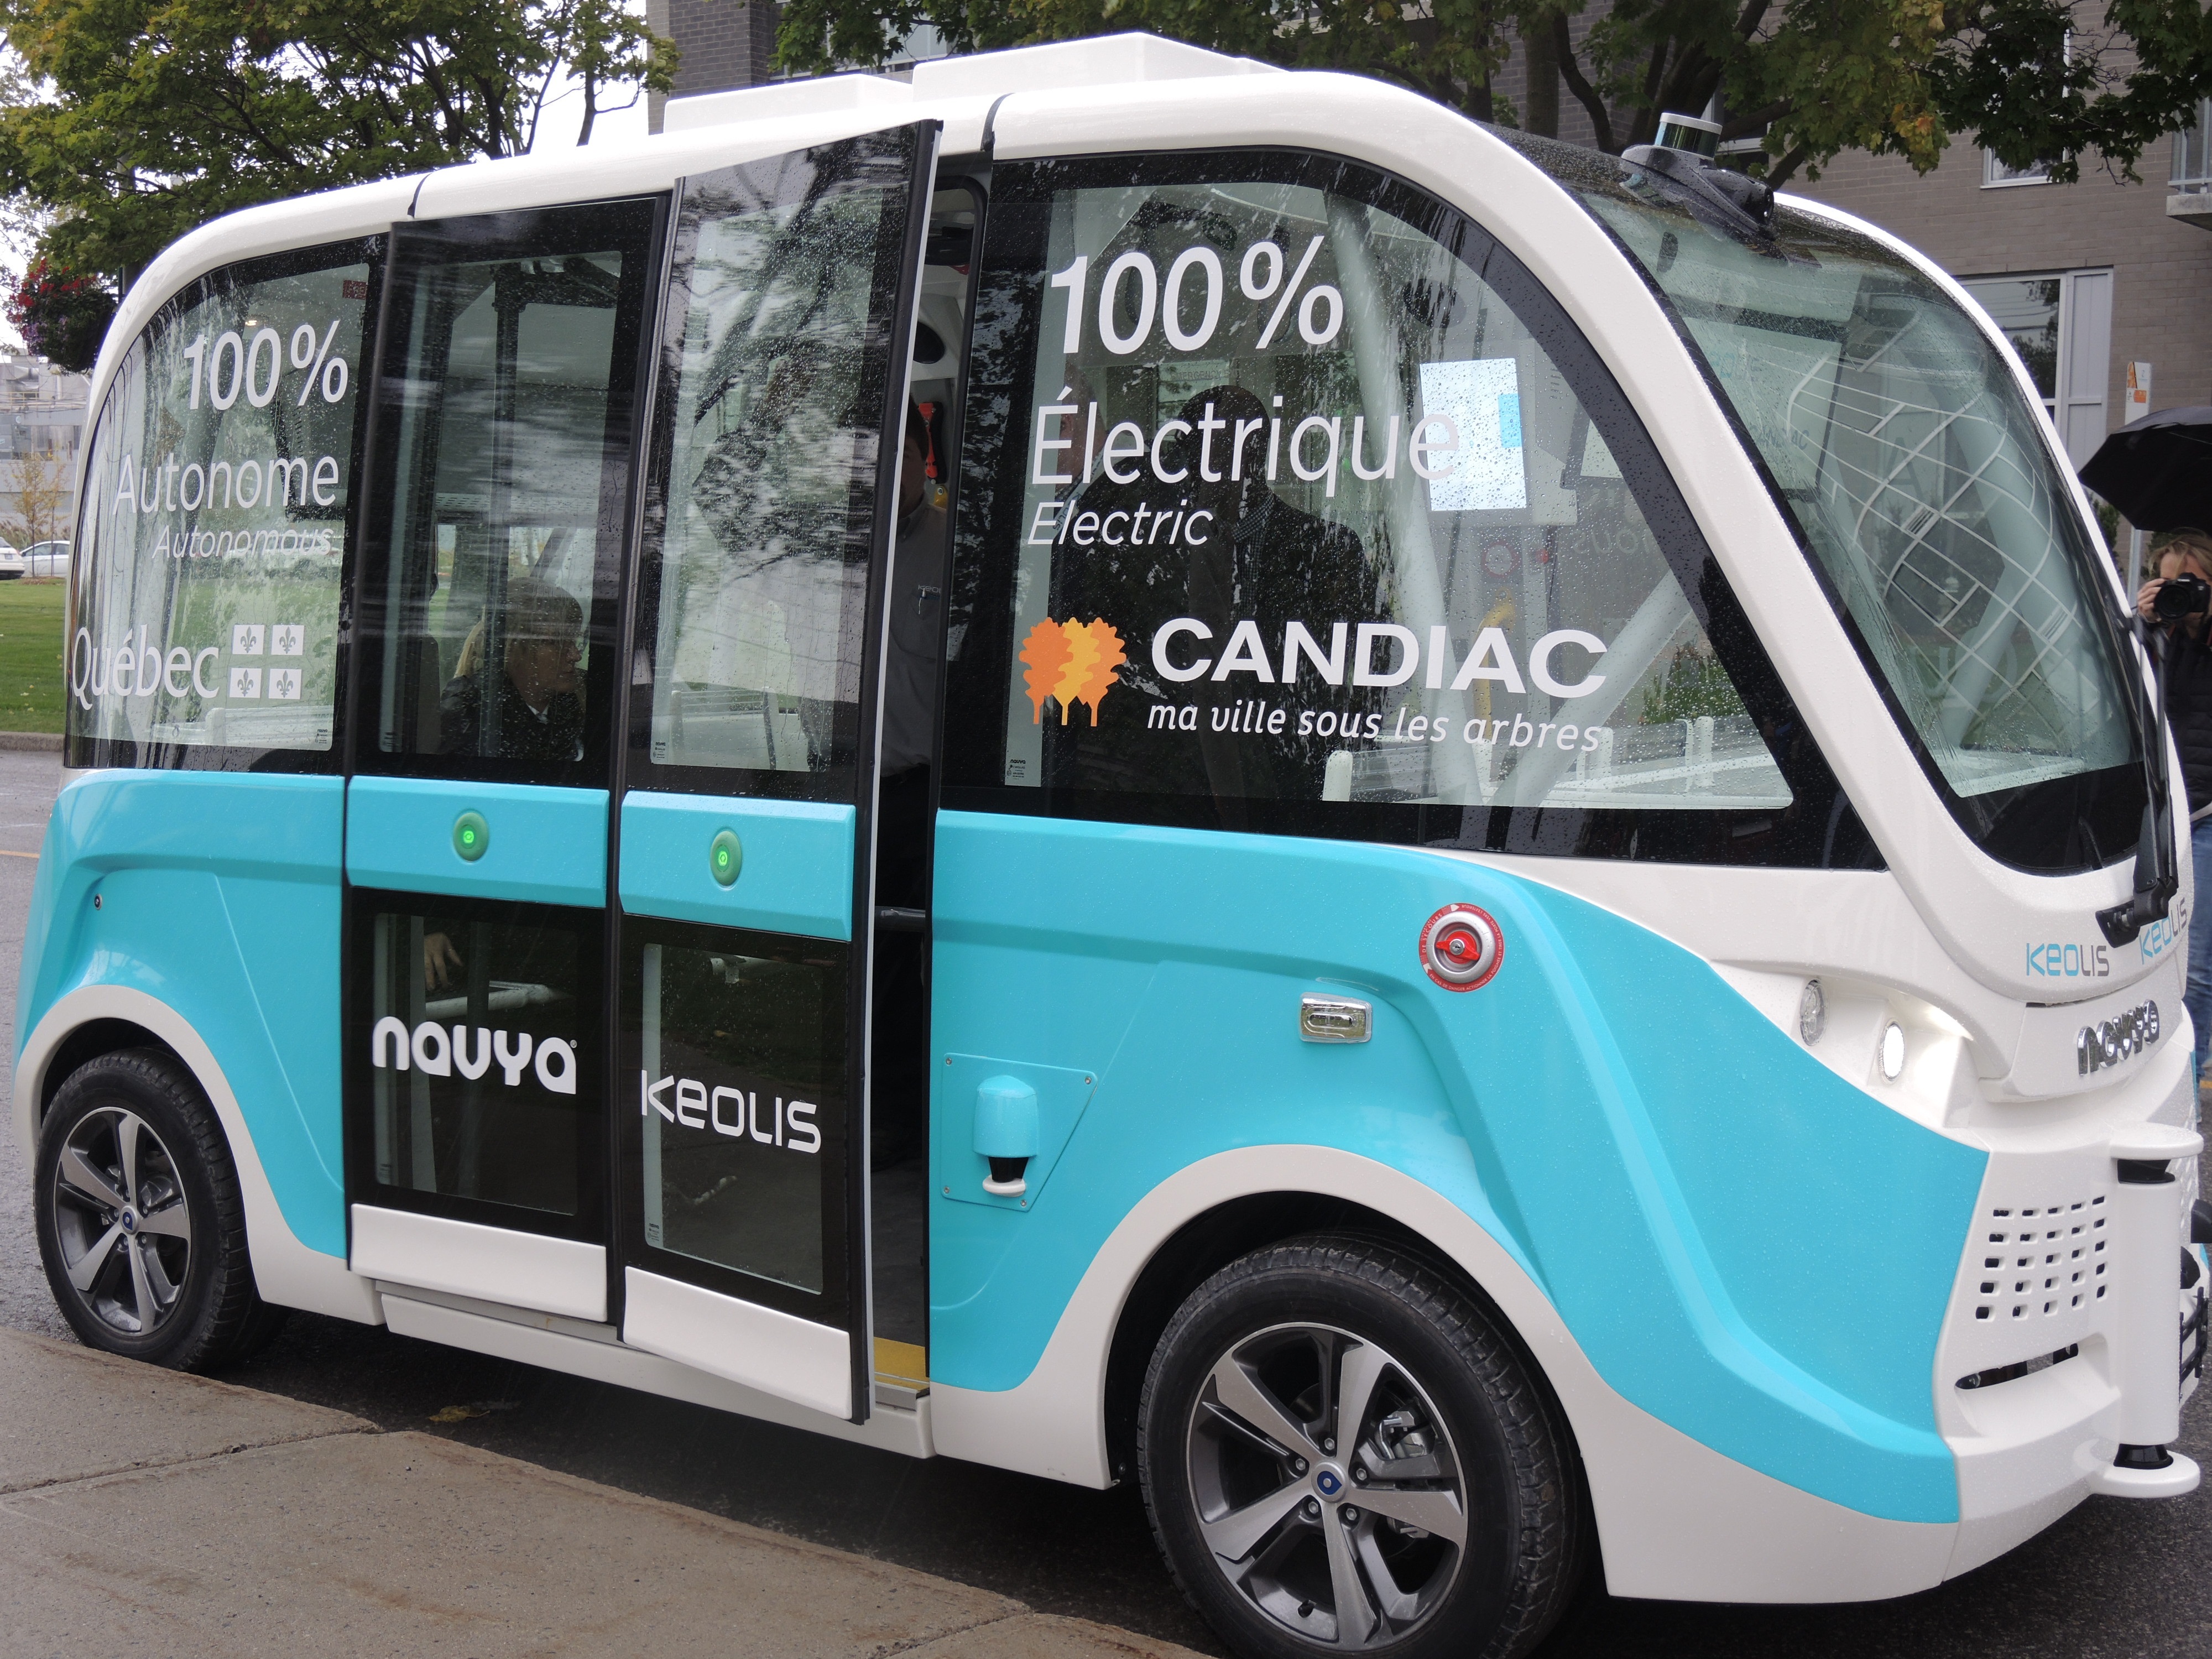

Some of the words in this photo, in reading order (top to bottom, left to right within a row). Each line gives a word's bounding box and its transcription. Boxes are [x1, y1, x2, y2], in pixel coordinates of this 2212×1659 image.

[1051, 236, 1343, 354] 100%
[184, 320, 348, 410] 100%
[1032, 387, 1459, 497] Électrique
[113, 454, 339, 515] Autonome
[152, 524, 333, 559] Autonomous
[1027, 500, 1213, 545] Electric
[72, 624, 220, 711] Québec
[1152, 618, 1607, 698] CANDIAC
[1147, 705, 1197, 731] ma
[1211, 699, 1286, 734] ville
[1297, 711, 1382, 739] sous
[1394, 707, 1449, 742] les
[1463, 713, 1603, 752] arbres
[1421, 944, 1426, 953] DE
[1423, 912, 1442, 941] SECOURS
